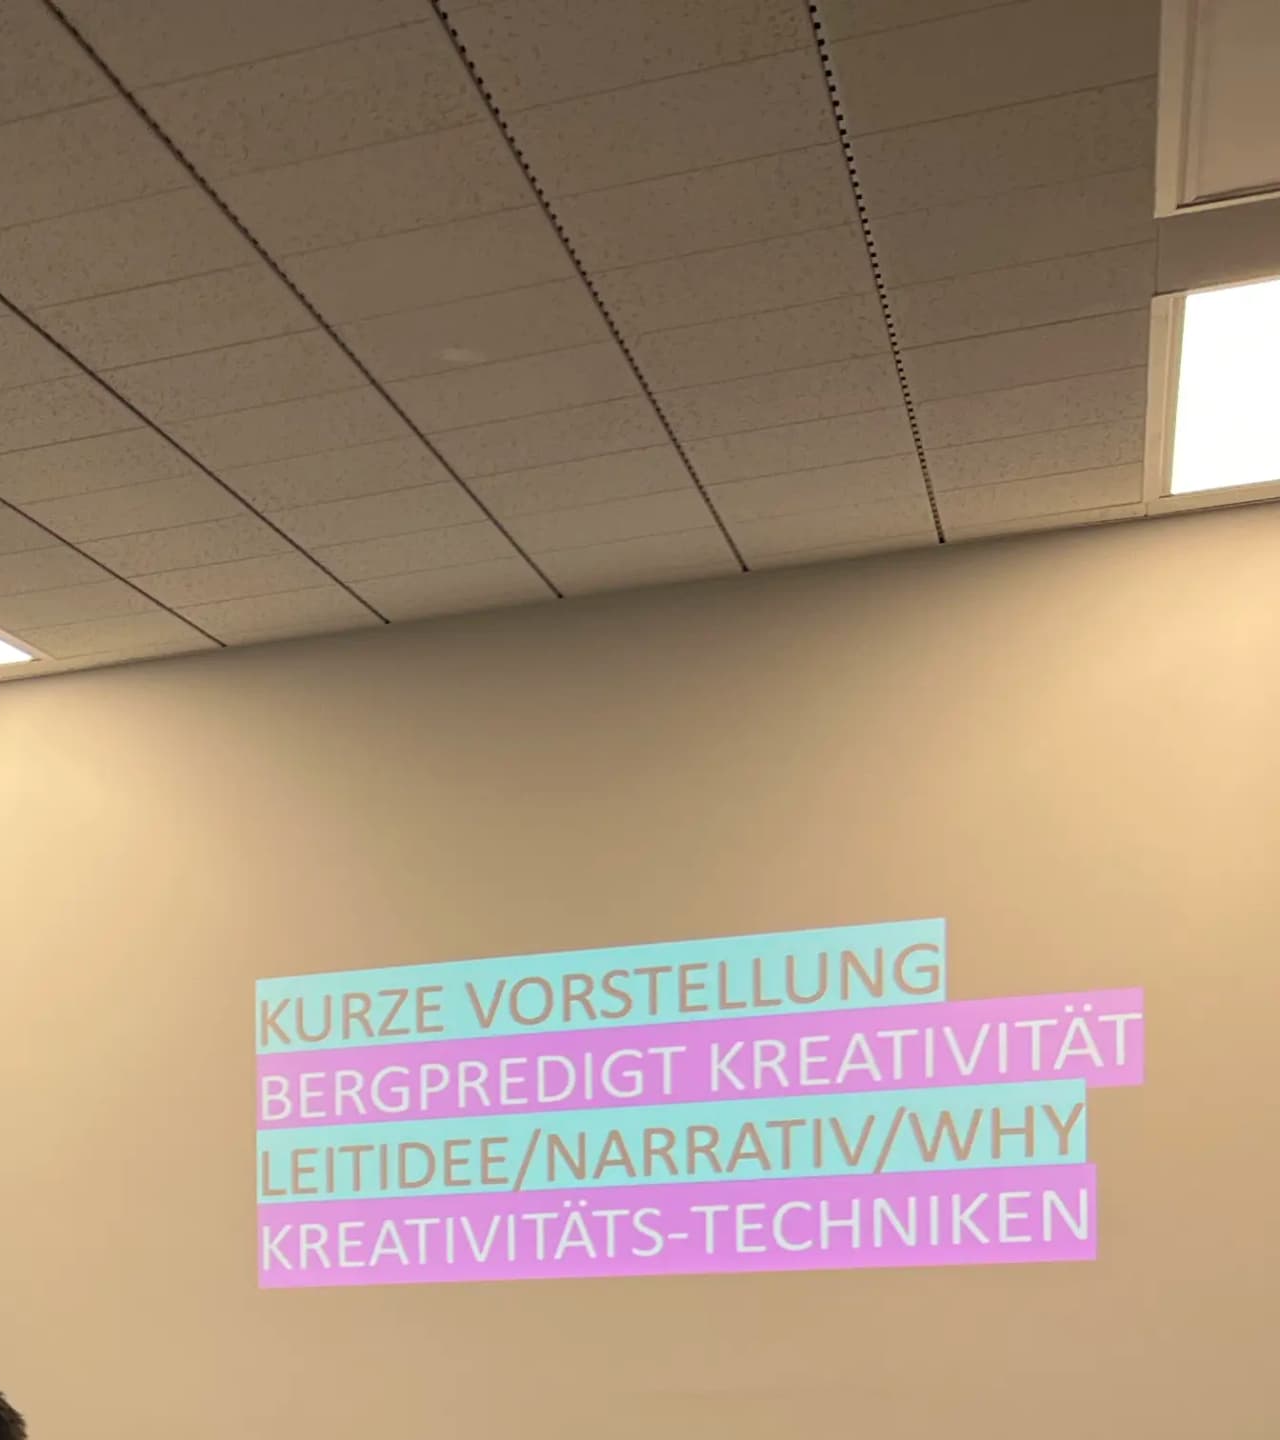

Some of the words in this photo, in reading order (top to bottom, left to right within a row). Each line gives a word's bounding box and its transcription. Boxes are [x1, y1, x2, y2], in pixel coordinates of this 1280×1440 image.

[259, 985, 445, 1047] KURZE
[465, 943, 941, 1029] VORSTELLUNG
[260, 1045, 687, 1122] BERGPREDIGT
[709, 1003, 1143, 1092] KREATIVITÄT
[261, 1102, 1085, 1196] LEITIDEE/NARRATIV/WHY
[262, 1188, 1089, 1272] KREATIVITÄTS-TECHNIKEN
